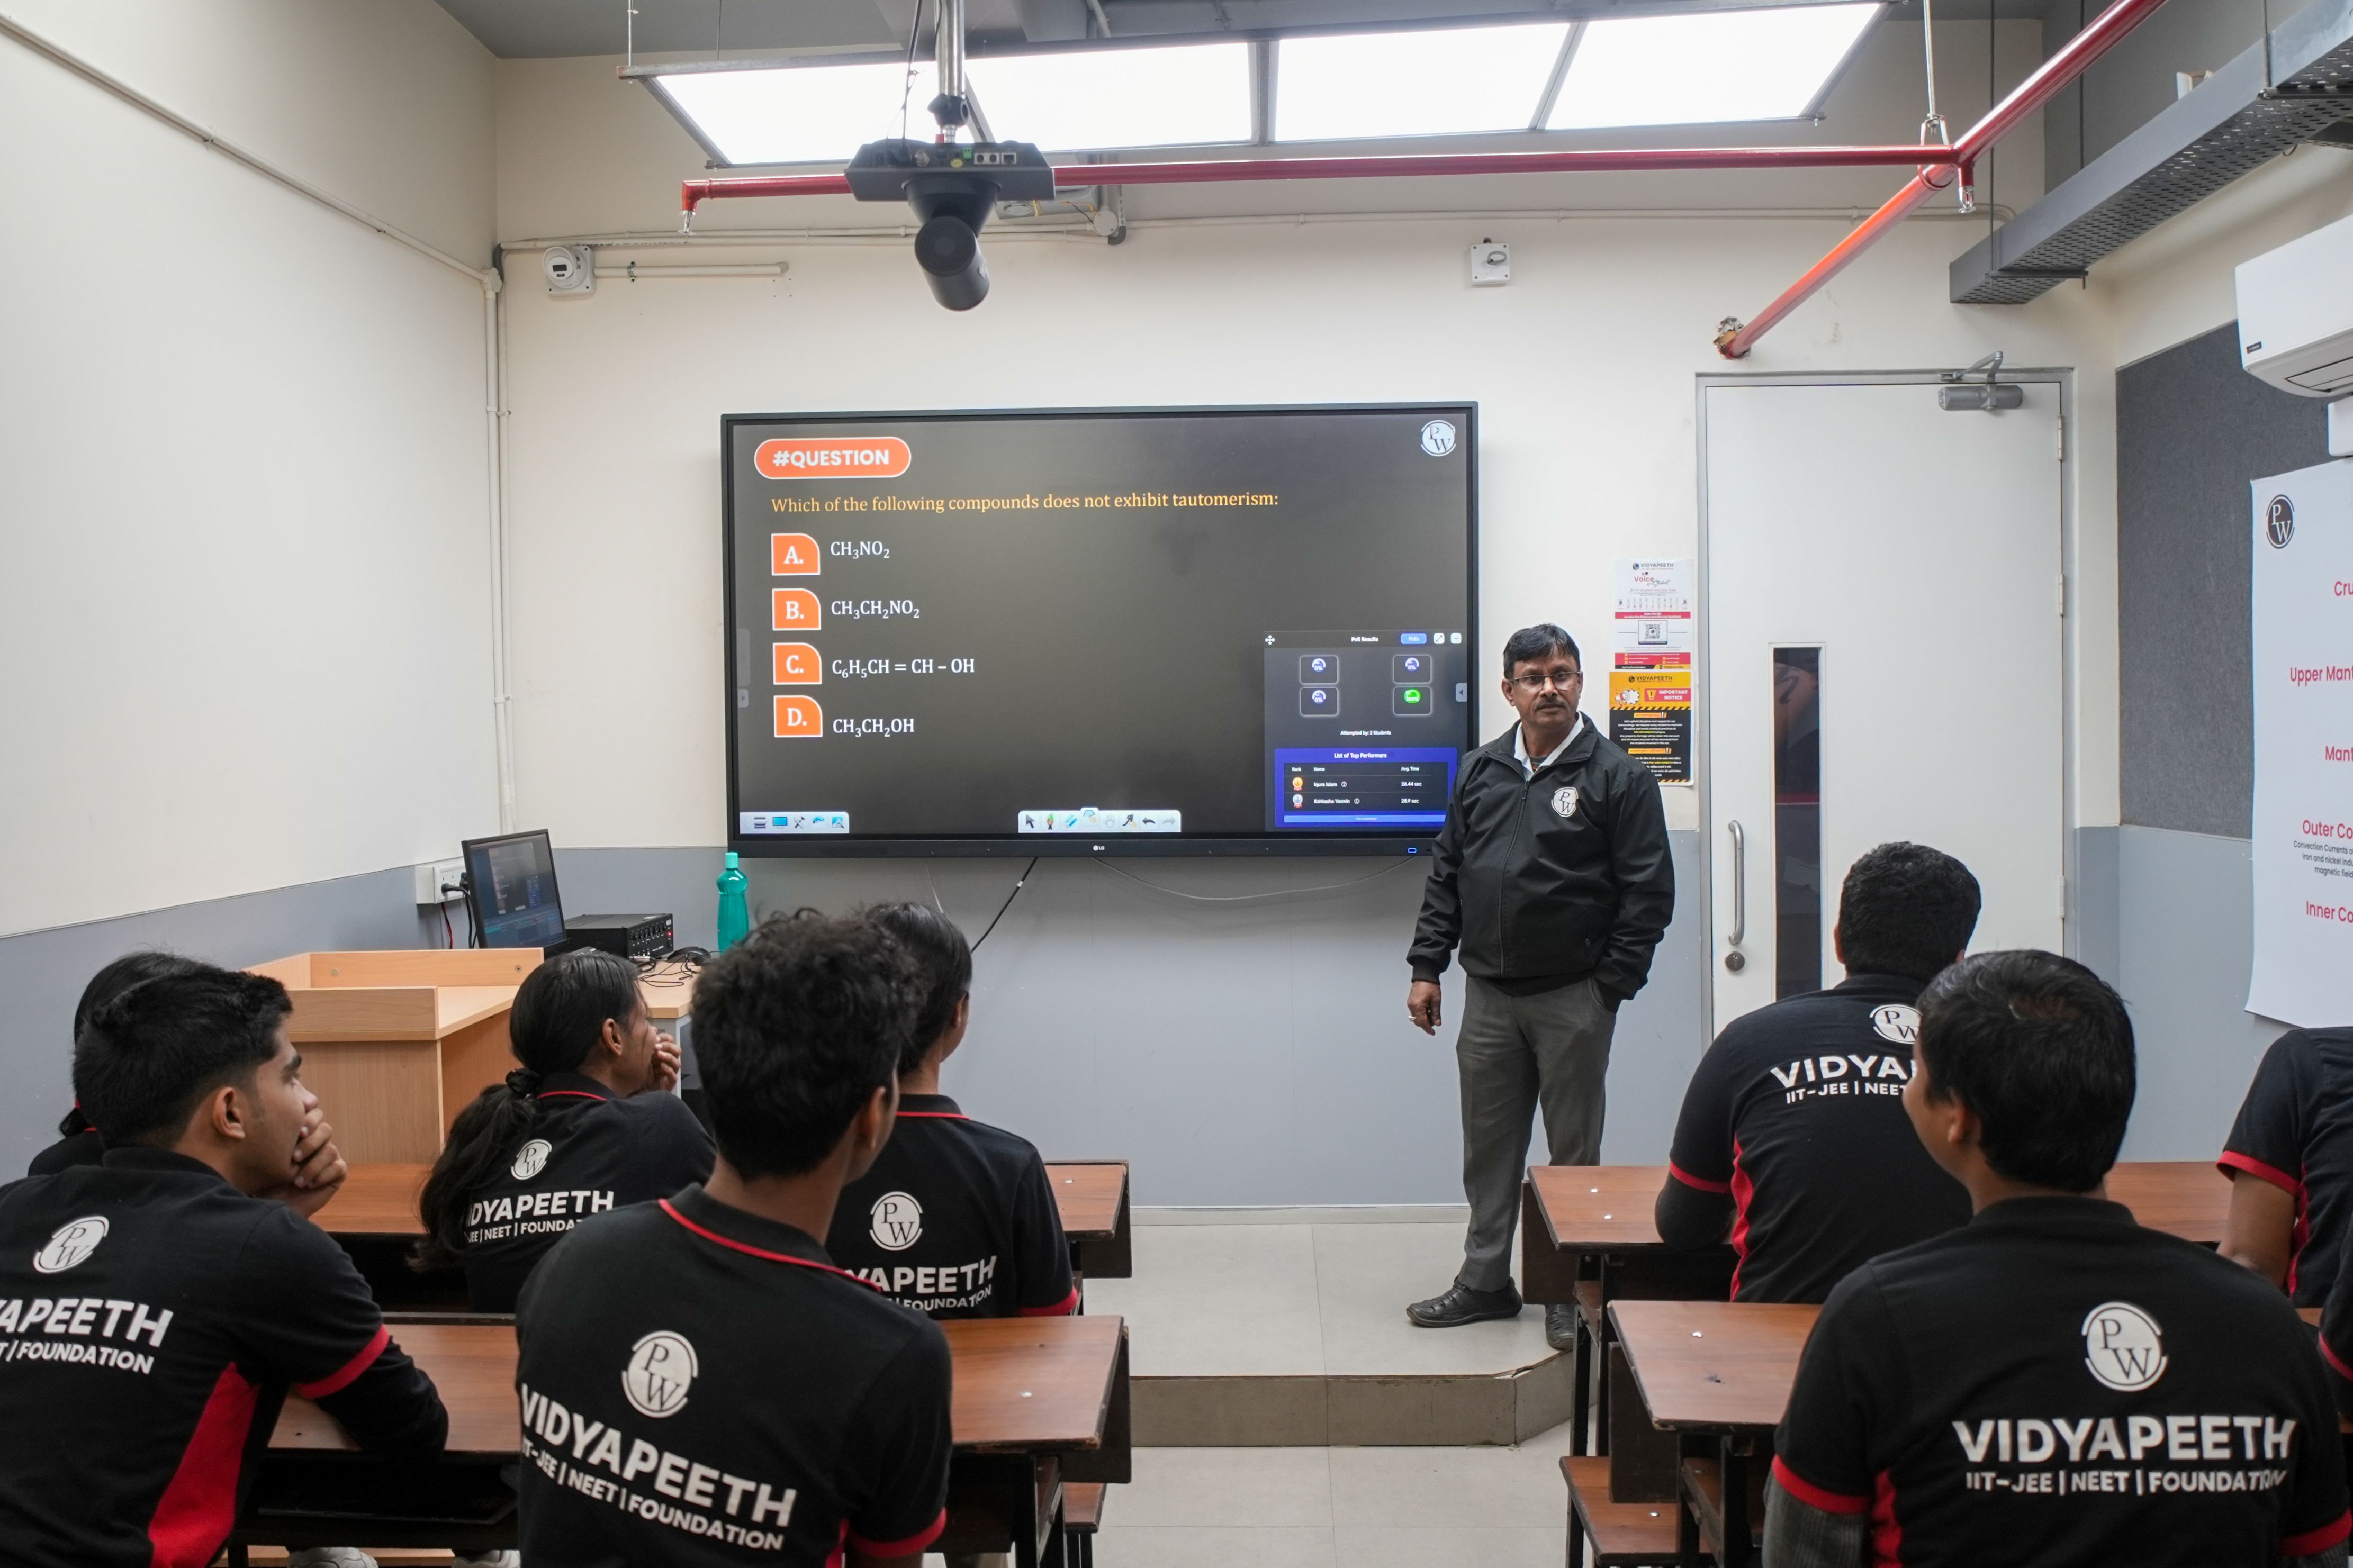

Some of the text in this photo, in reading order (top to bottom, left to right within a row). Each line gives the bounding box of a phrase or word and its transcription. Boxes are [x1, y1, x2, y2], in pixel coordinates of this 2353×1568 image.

[772, 450, 890, 468] #QUESTION
[771, 492, 1278, 513] Which of the following compounds does not exhibit tautomerism:
[783, 546, 804, 564] A.
[786, 601, 805, 619] B.
[786, 655, 804, 674] C.
[911, 659, 933, 673] CH
[951, 658, 975, 673] OH
[2290, 667, 2323, 687] Upper
[787, 707, 807, 727] D.
[2303, 819, 2334, 837] Outer
[2293, 840, 2323, 851] Convection
[2324, 844, 2348, 855] Currents
[2302, 852, 2312, 861] iron
[2313, 854, 2324, 863] and
[2325, 856, 2341, 865] nickel
[2314, 866, 2340, 876] magnetic
[2306, 900, 2335, 920] Inner
[1786, 1082, 1848, 1104] IIT-JEE
[485, 1225, 512, 1240] NEET
[521, 1219, 583, 1235] FOUNDA
[16, 1342, 154, 1375] FOUNDATION
[1952, 1415, 2297, 1463] VIDYAPEETH
[521, 1382, 797, 1527] VIDYAPEETH
[1966, 1471, 2053, 1494] IIT-JEE
[2071, 1471, 2130, 1493] NEET
[567, 1467, 619, 1503] NEET
[627, 1493, 784, 1551] FOUNDATION
